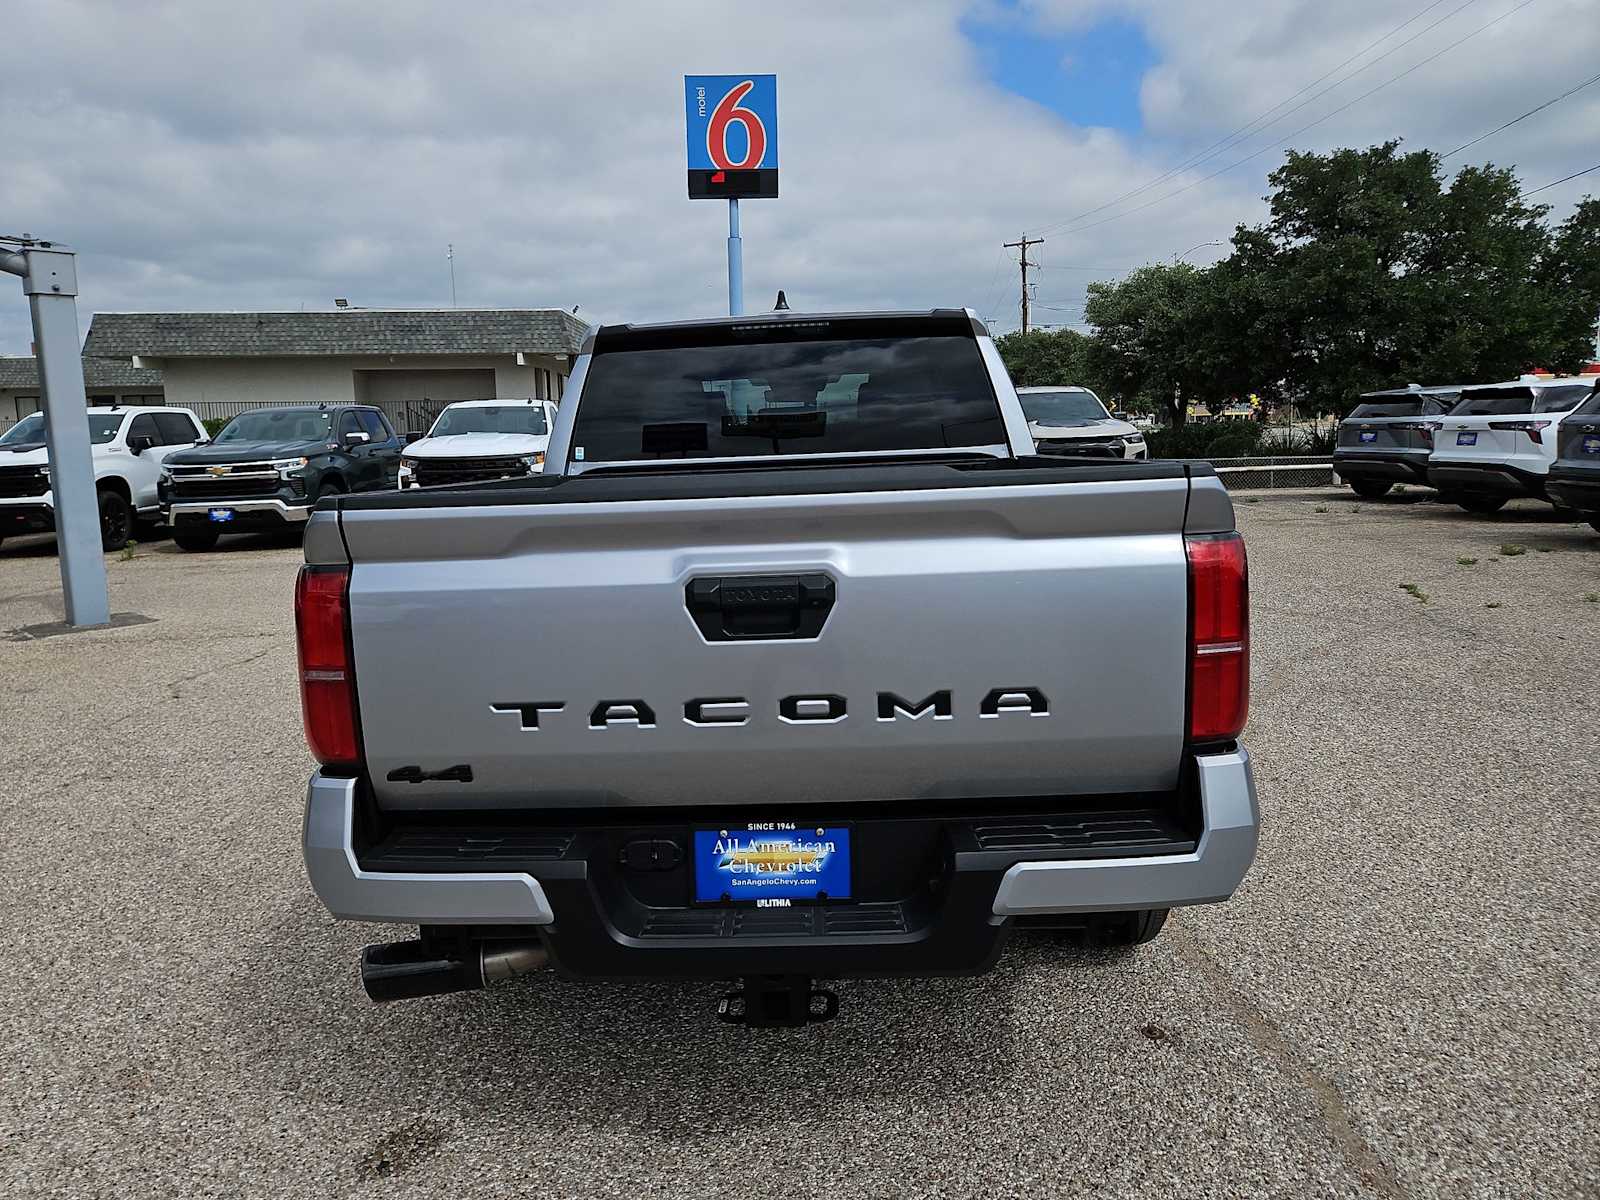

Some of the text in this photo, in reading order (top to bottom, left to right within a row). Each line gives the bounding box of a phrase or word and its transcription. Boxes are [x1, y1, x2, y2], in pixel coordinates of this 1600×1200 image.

[696, 87, 706, 116] motel
[706, 81, 767, 170] 6
[489, 687, 1050, 731] TACOMA
[747, 822, 796, 831] SINCE 1946
[712, 838, 836, 855] All American
[729, 858, 823, 874] Chevrolet
[731, 878, 817, 887] SanAngeloChevy.com
